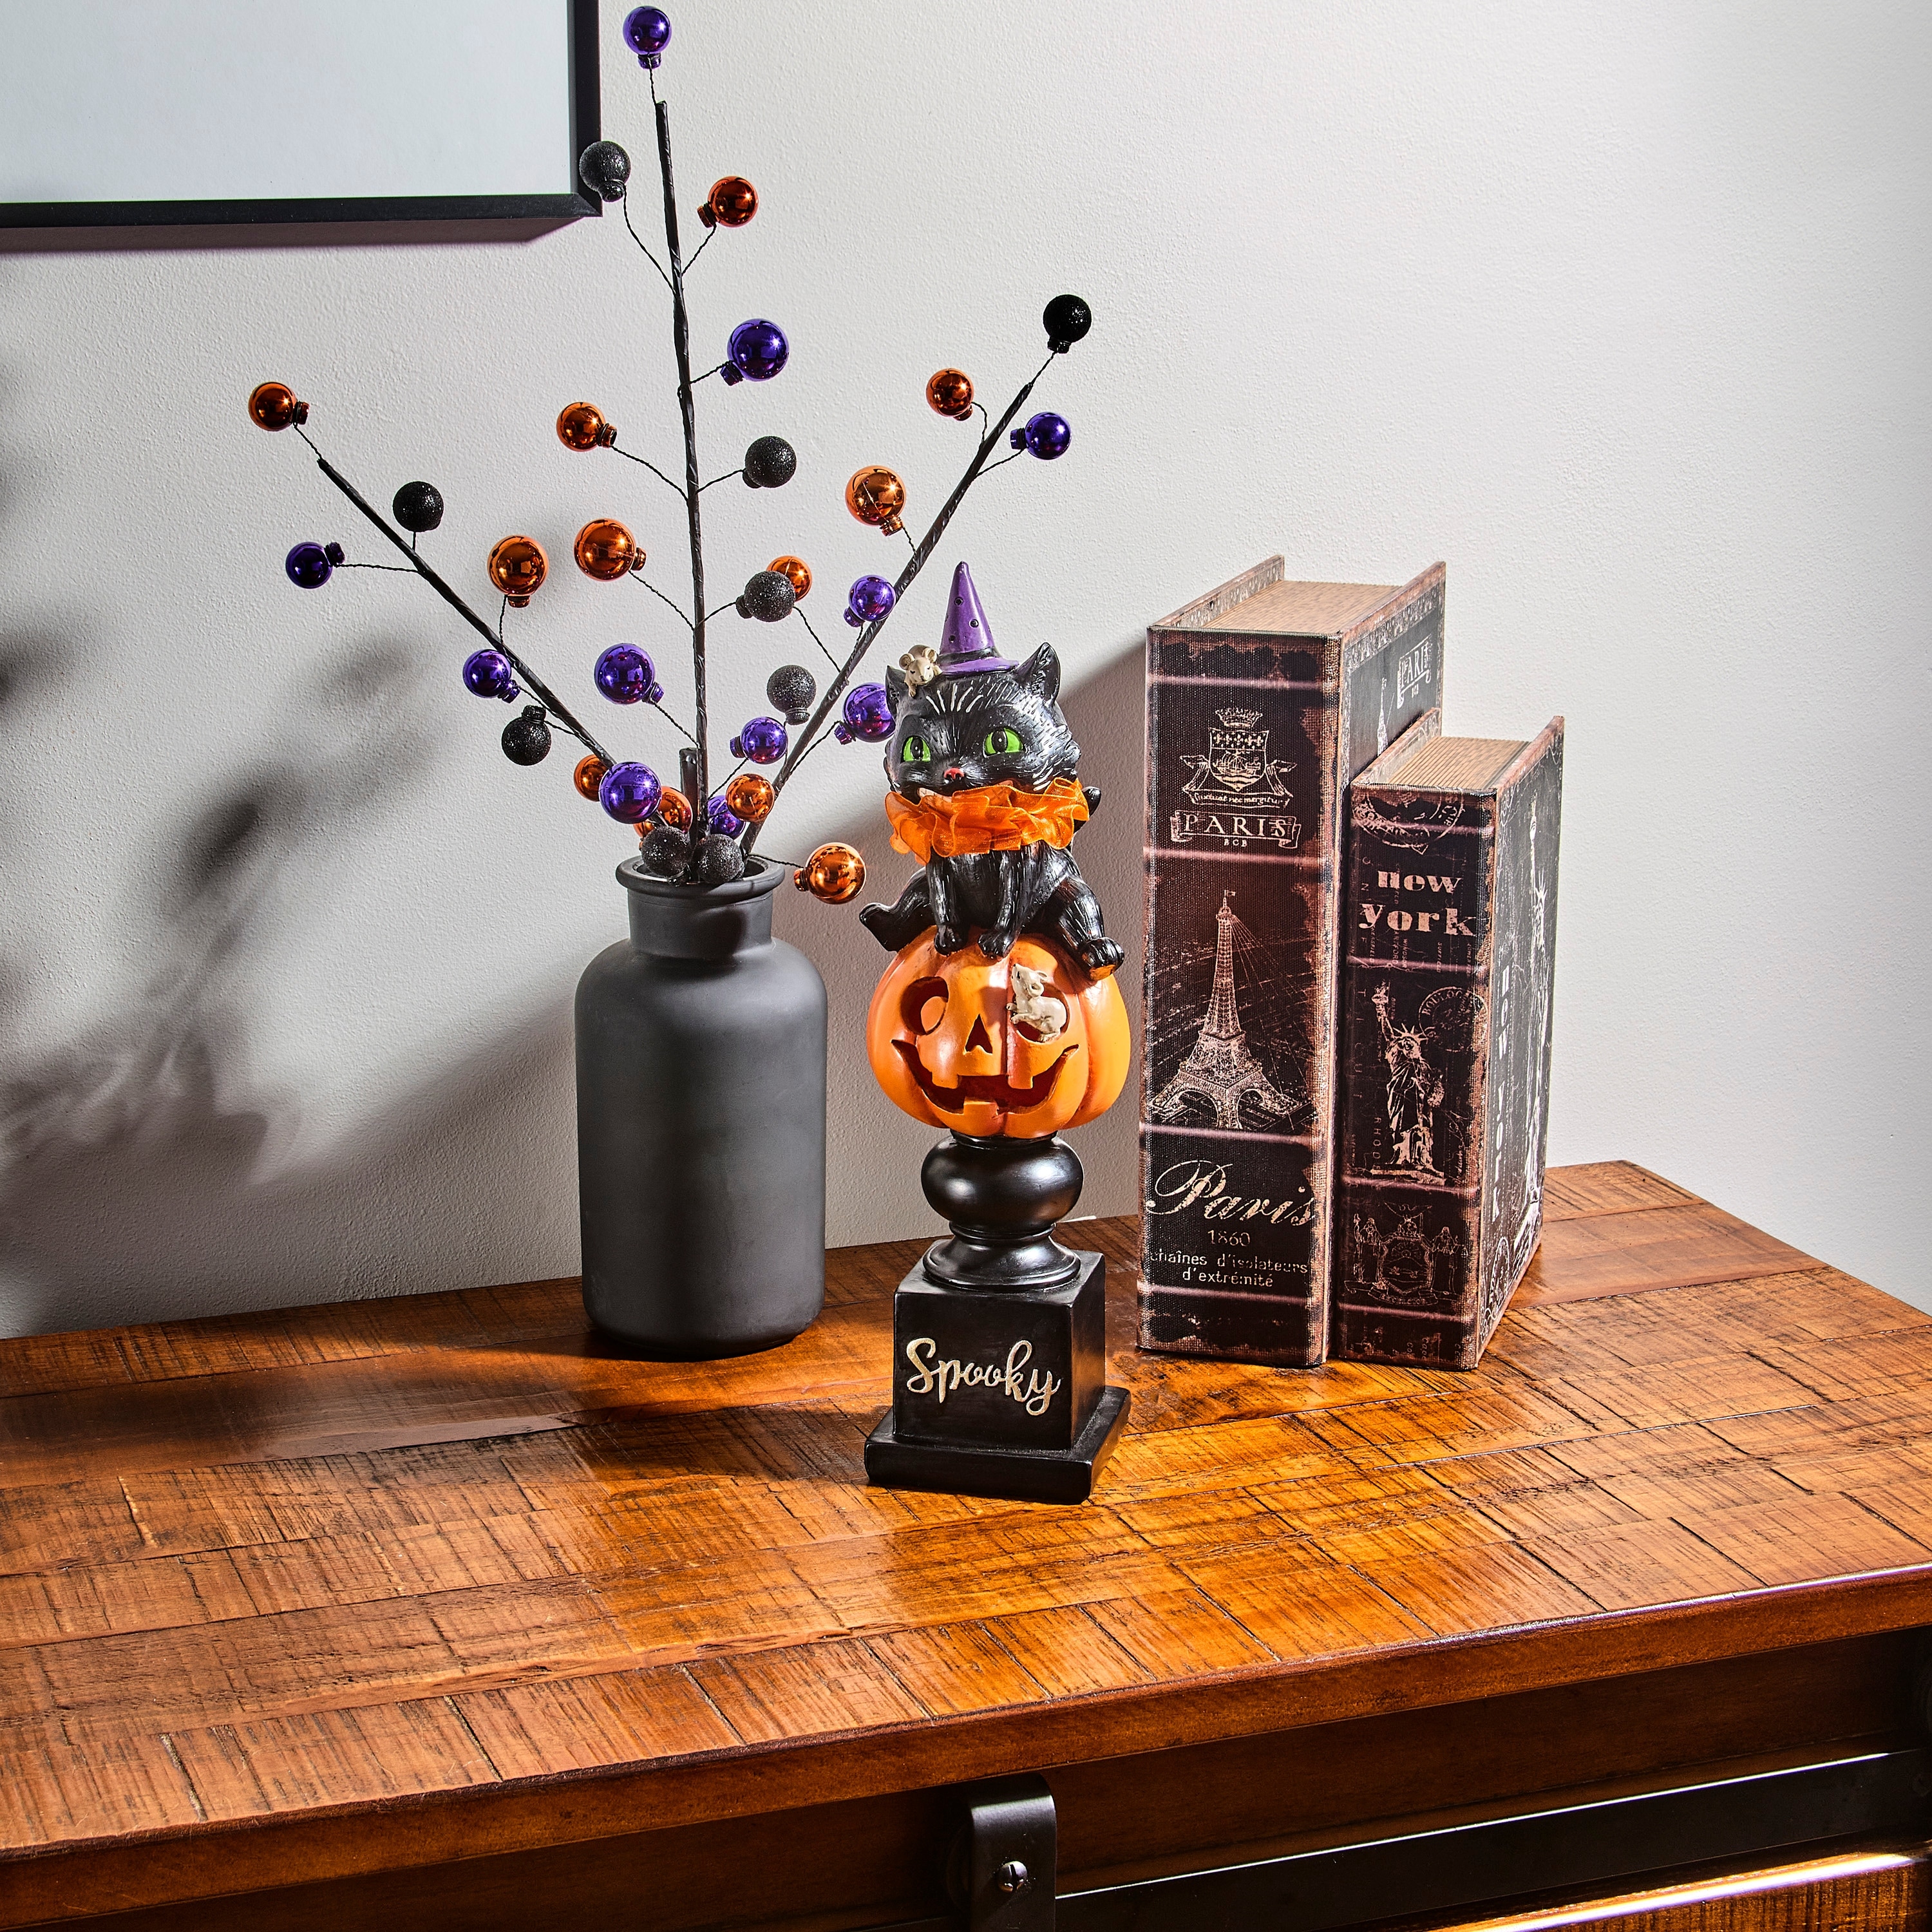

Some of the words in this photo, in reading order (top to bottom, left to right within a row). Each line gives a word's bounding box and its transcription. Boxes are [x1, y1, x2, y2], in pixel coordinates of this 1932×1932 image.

[1183, 813, 1286, 837] PARIS
[1377, 869, 1463, 894] new
[1358, 903, 1477, 936] york
[1145, 1159, 1316, 1227] Paris
[1208, 1229, 1251, 1247] 1860
[906, 1337, 1062, 1416] Spooky
